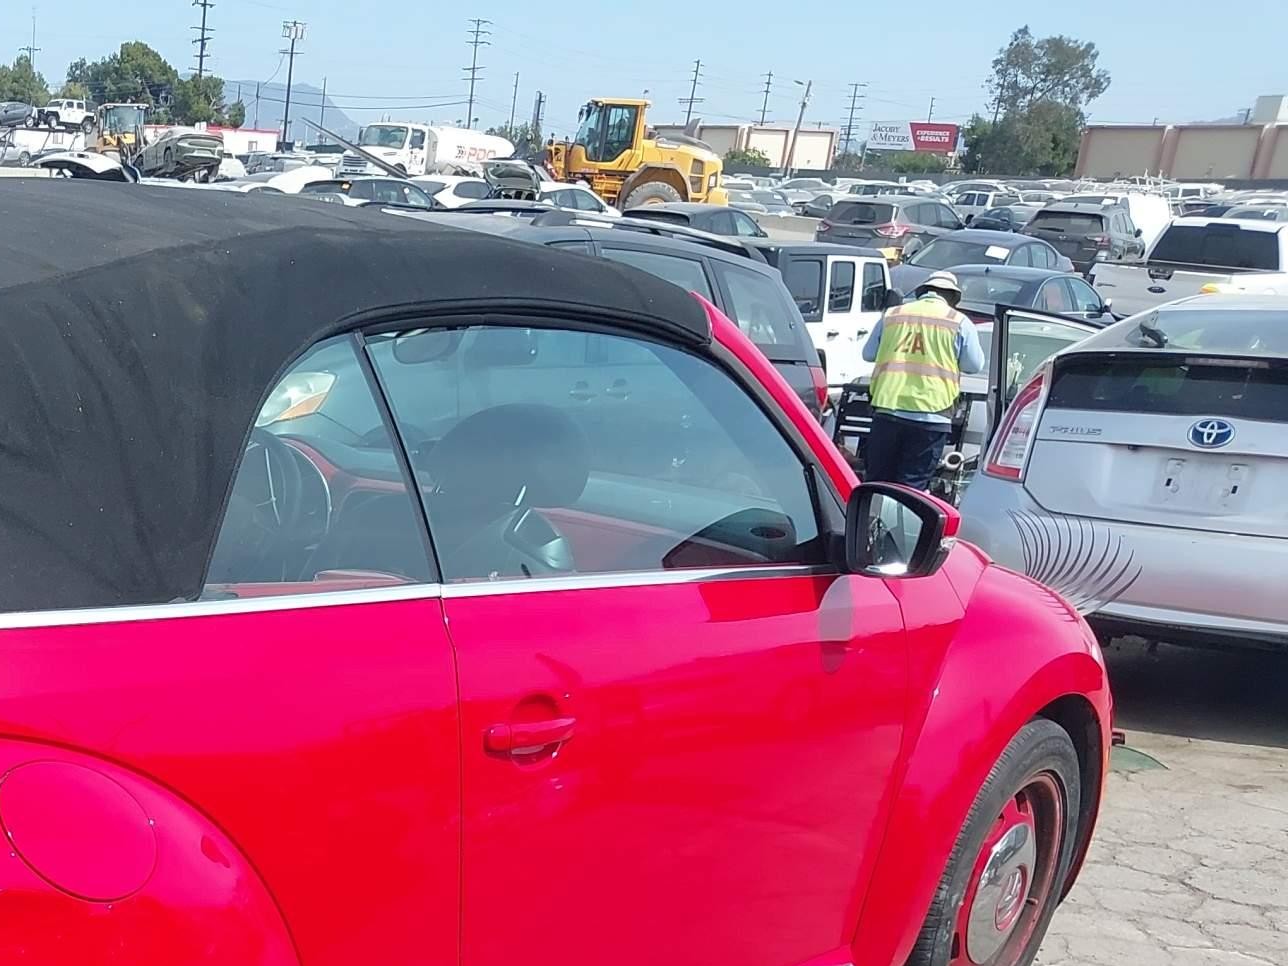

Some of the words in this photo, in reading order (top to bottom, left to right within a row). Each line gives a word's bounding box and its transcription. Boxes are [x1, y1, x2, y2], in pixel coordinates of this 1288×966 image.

[872, 123, 901, 133] JACOBY
[879, 132, 910, 142] MEYERS
[1049, 425, 1103, 436] PRIUS
